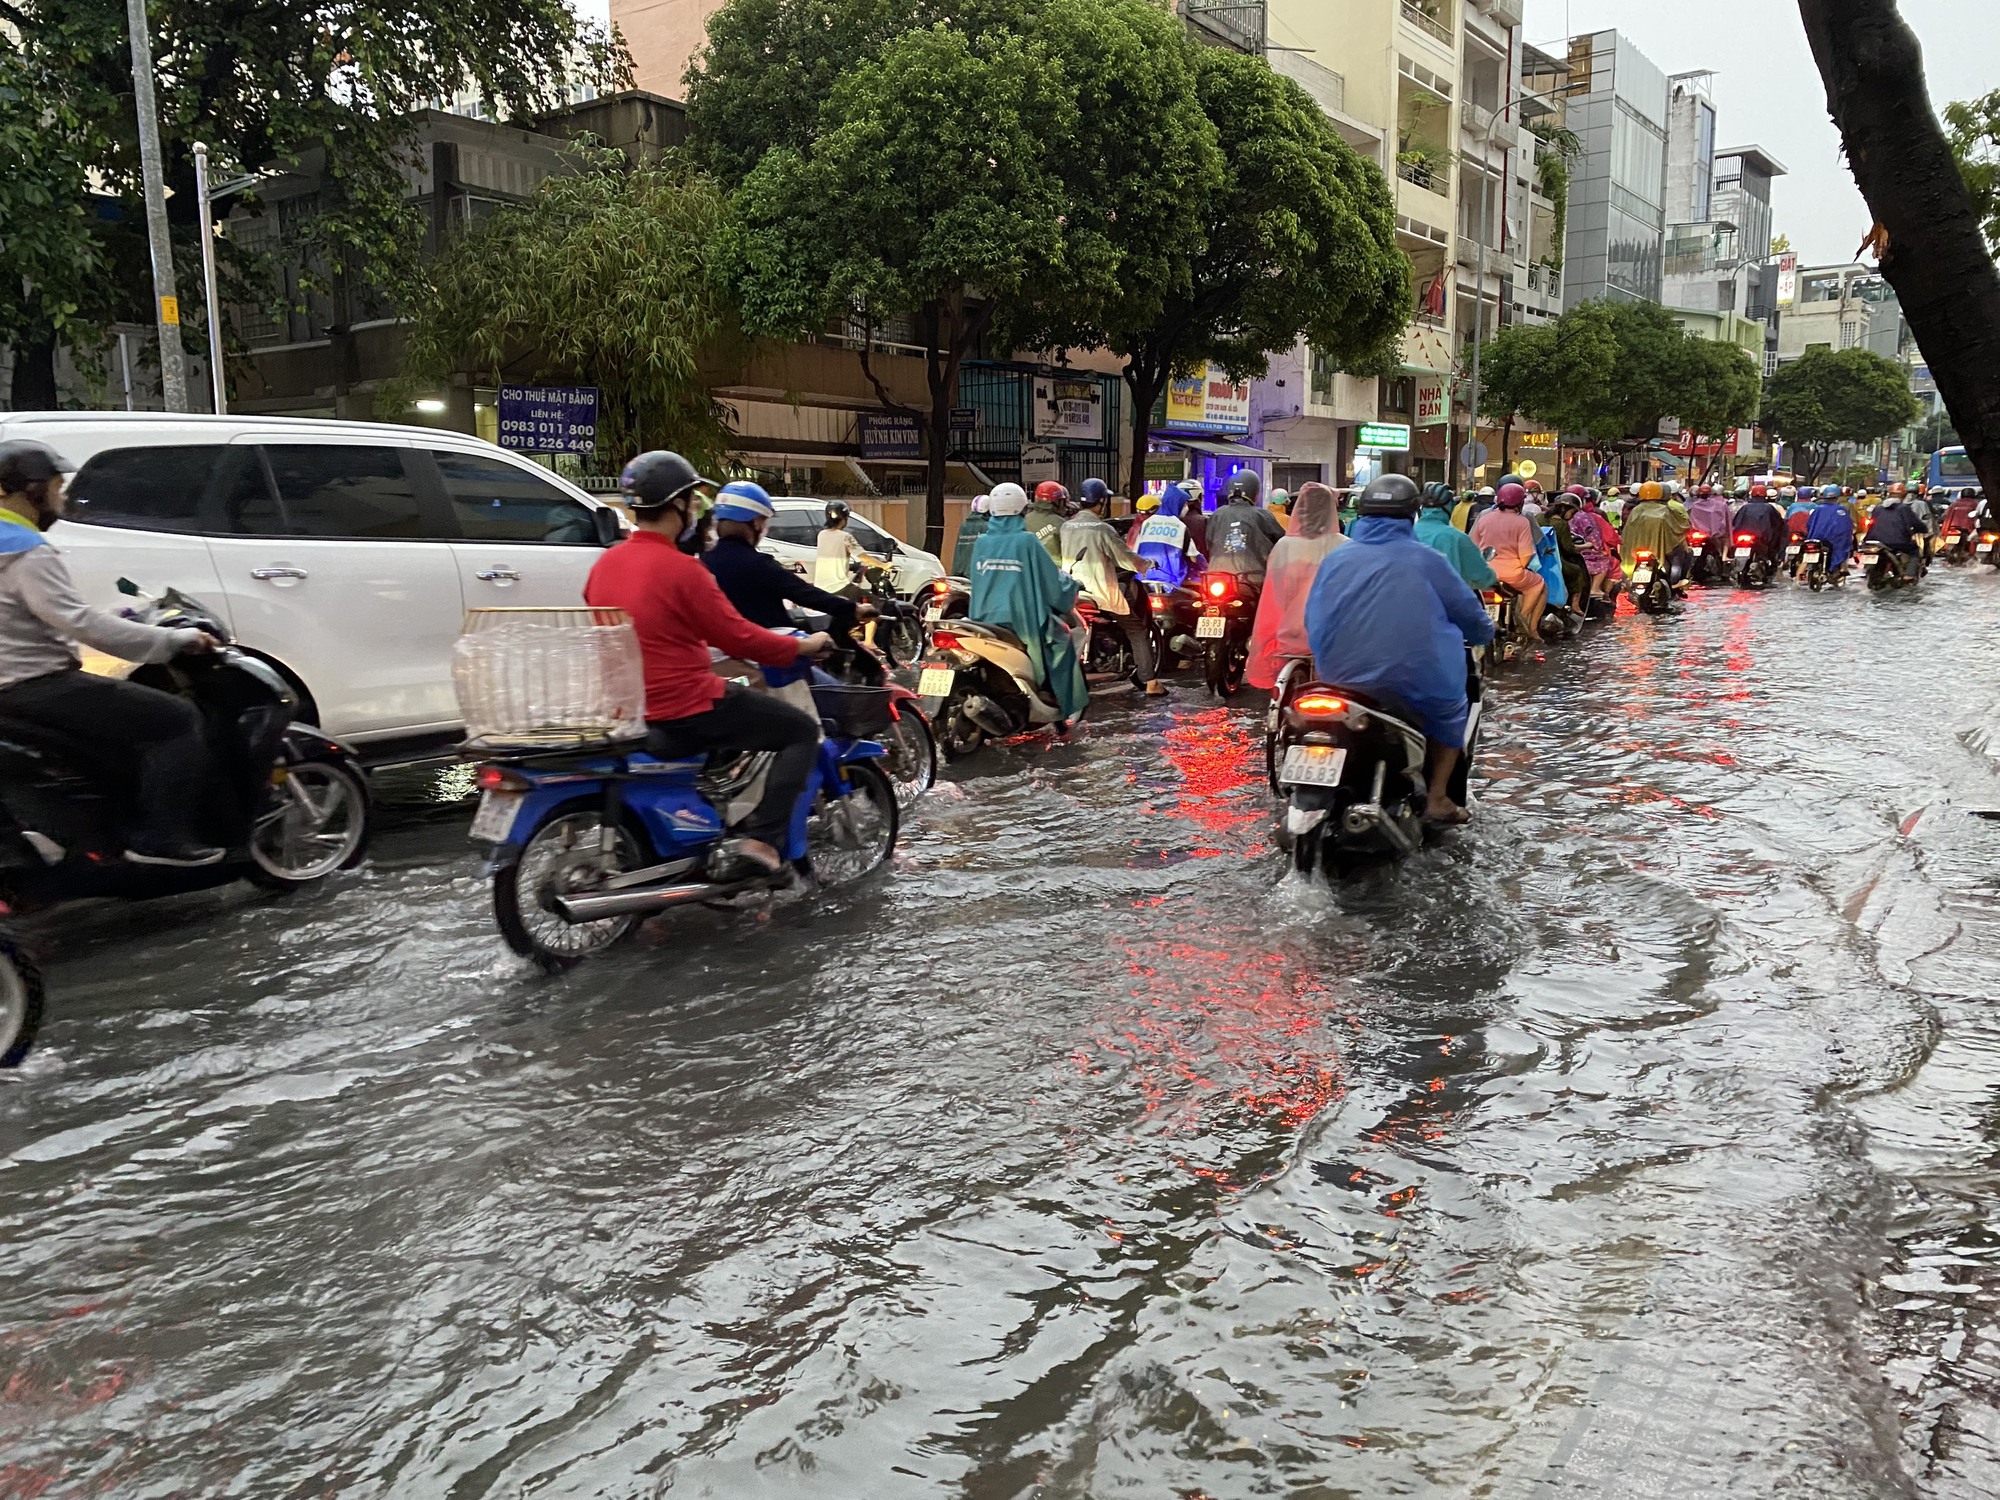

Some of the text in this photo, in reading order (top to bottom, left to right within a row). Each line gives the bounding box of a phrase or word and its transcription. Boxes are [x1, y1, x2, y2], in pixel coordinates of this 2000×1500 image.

[502, 389, 594, 406] CHO THUÊ MẶT BẰNG
[1420, 384, 1442, 401] NHÀ
[531, 409, 564, 421] LIÊN HỆ:
[1419, 401, 1441, 416] BÁN
[501, 420, 594, 436] 0983 011 800
[864, 427, 889, 445] HUỲNH
[501, 435, 594, 452] 0918 226 449
[1148, 526, 1178, 537] 2000
